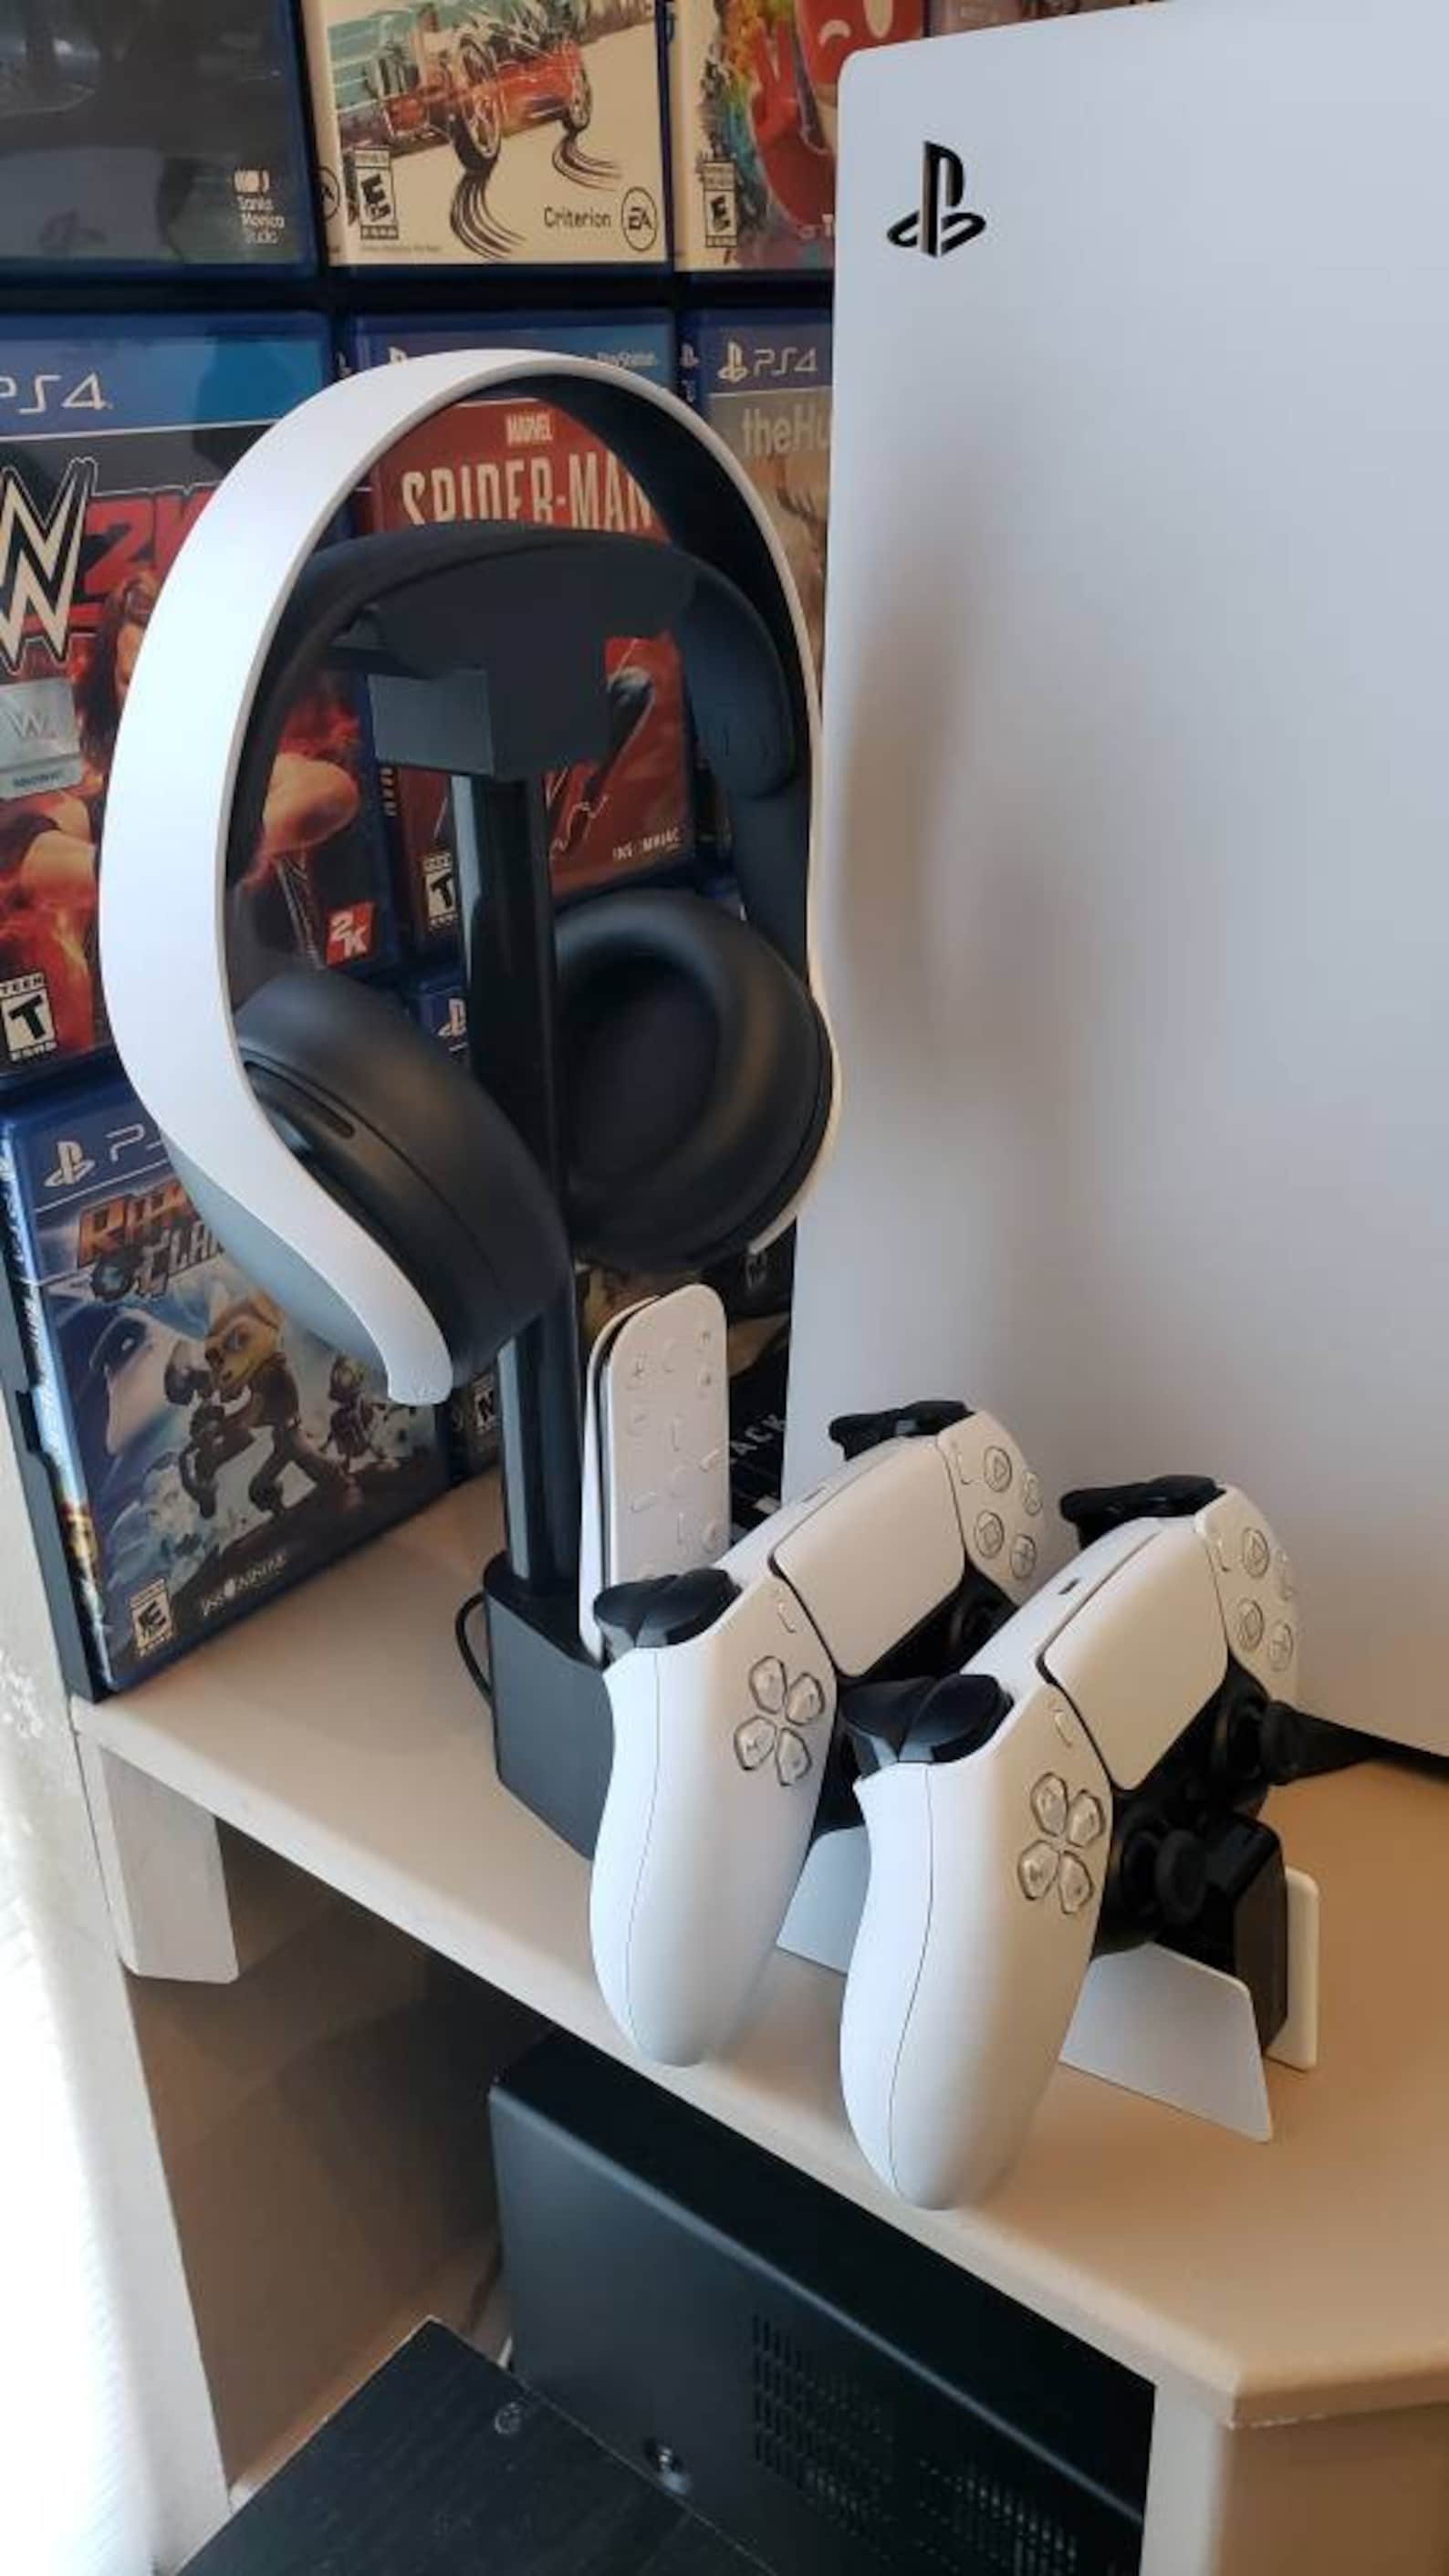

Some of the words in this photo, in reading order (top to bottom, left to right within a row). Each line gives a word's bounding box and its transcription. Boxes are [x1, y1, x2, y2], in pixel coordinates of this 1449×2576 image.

[543, 206, 612, 228] Criterion
[628, 206, 652, 230] EA
[754, 346, 818, 378] PS4
[506, 412, 553, 446] MARVEL
[430, 871, 453, 909] T
[329, 910, 369, 958] 2K
[1, 975, 43, 996] TEEN
[8, 994, 47, 1040] T
